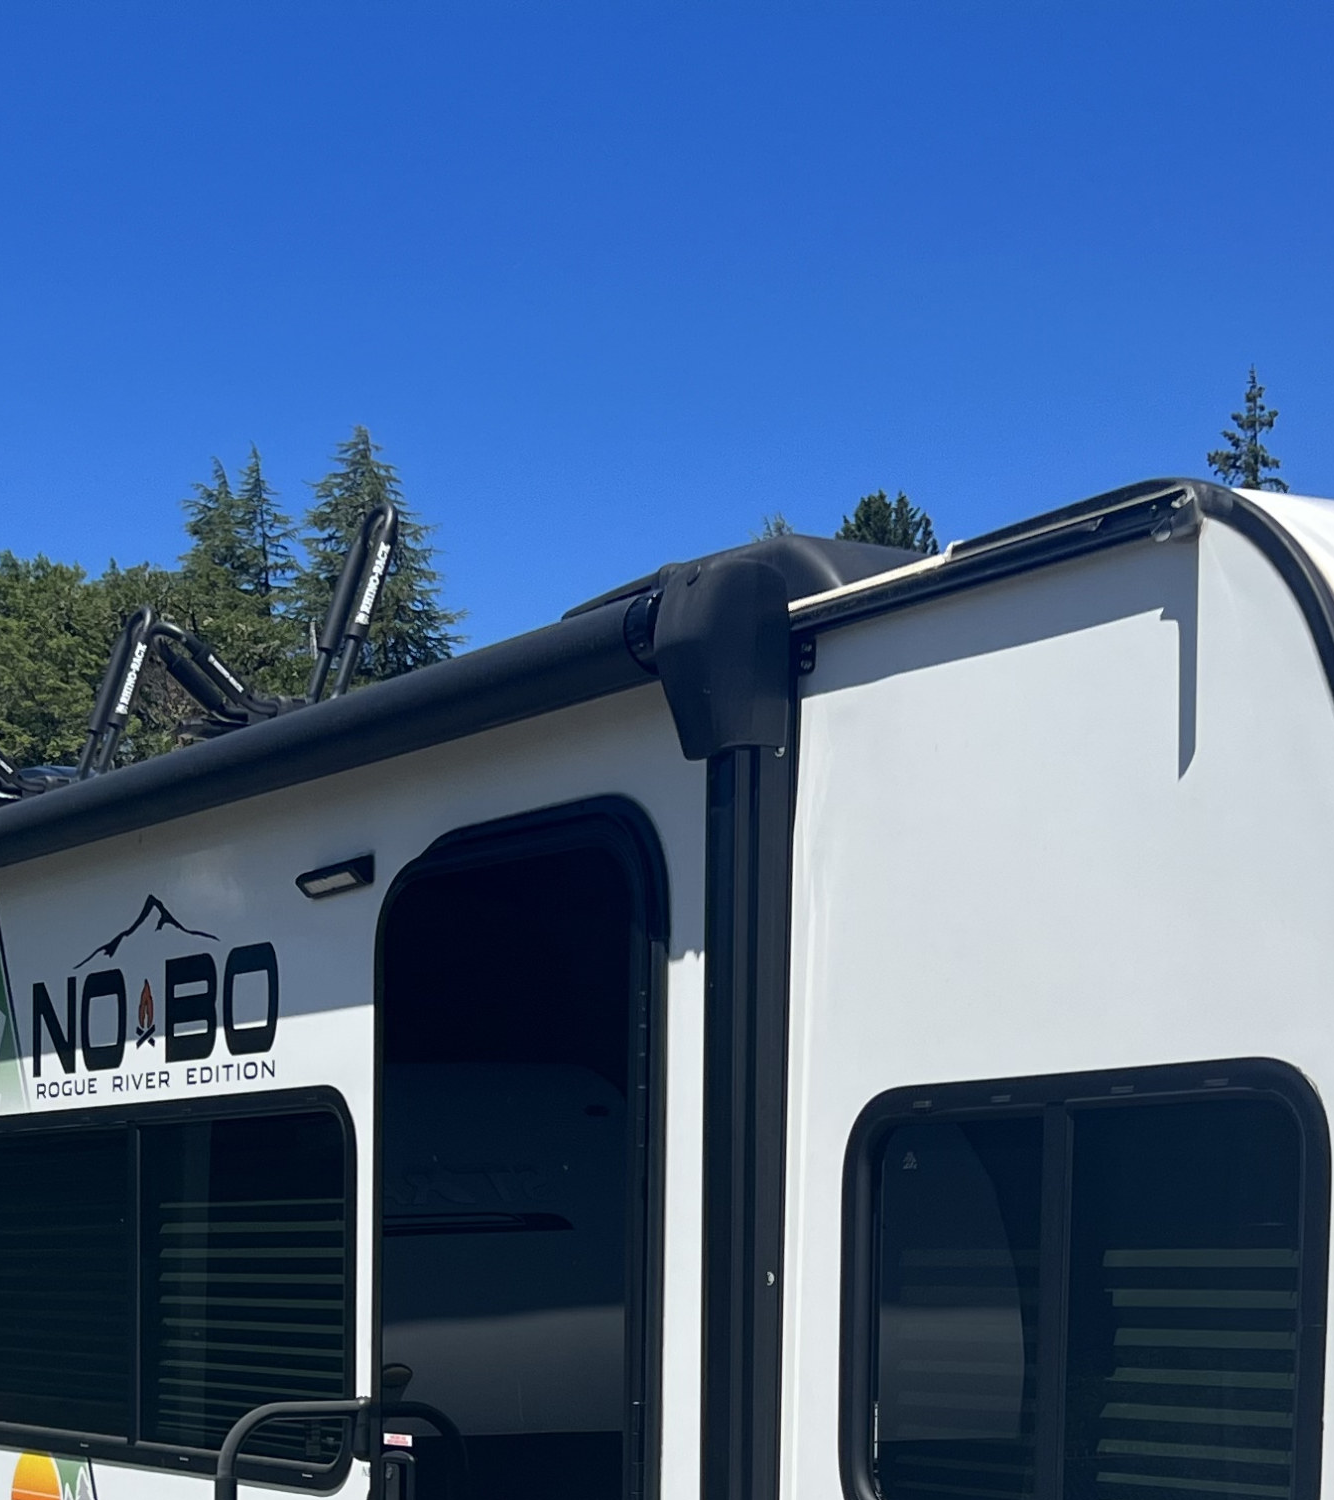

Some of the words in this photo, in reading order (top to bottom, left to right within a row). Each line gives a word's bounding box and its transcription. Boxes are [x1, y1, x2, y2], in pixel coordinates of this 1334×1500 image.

[359, 541, 391, 615] RHINO-RACK
[119, 641, 147, 706] RHINO-RACK
[32, 968, 127, 1078] NO
[165, 941, 279, 1064] BO
[36, 1077, 97, 1099] ROGUE
[112, 1071, 171, 1092] RIVER
[186, 1059, 276, 1085] EDITION
